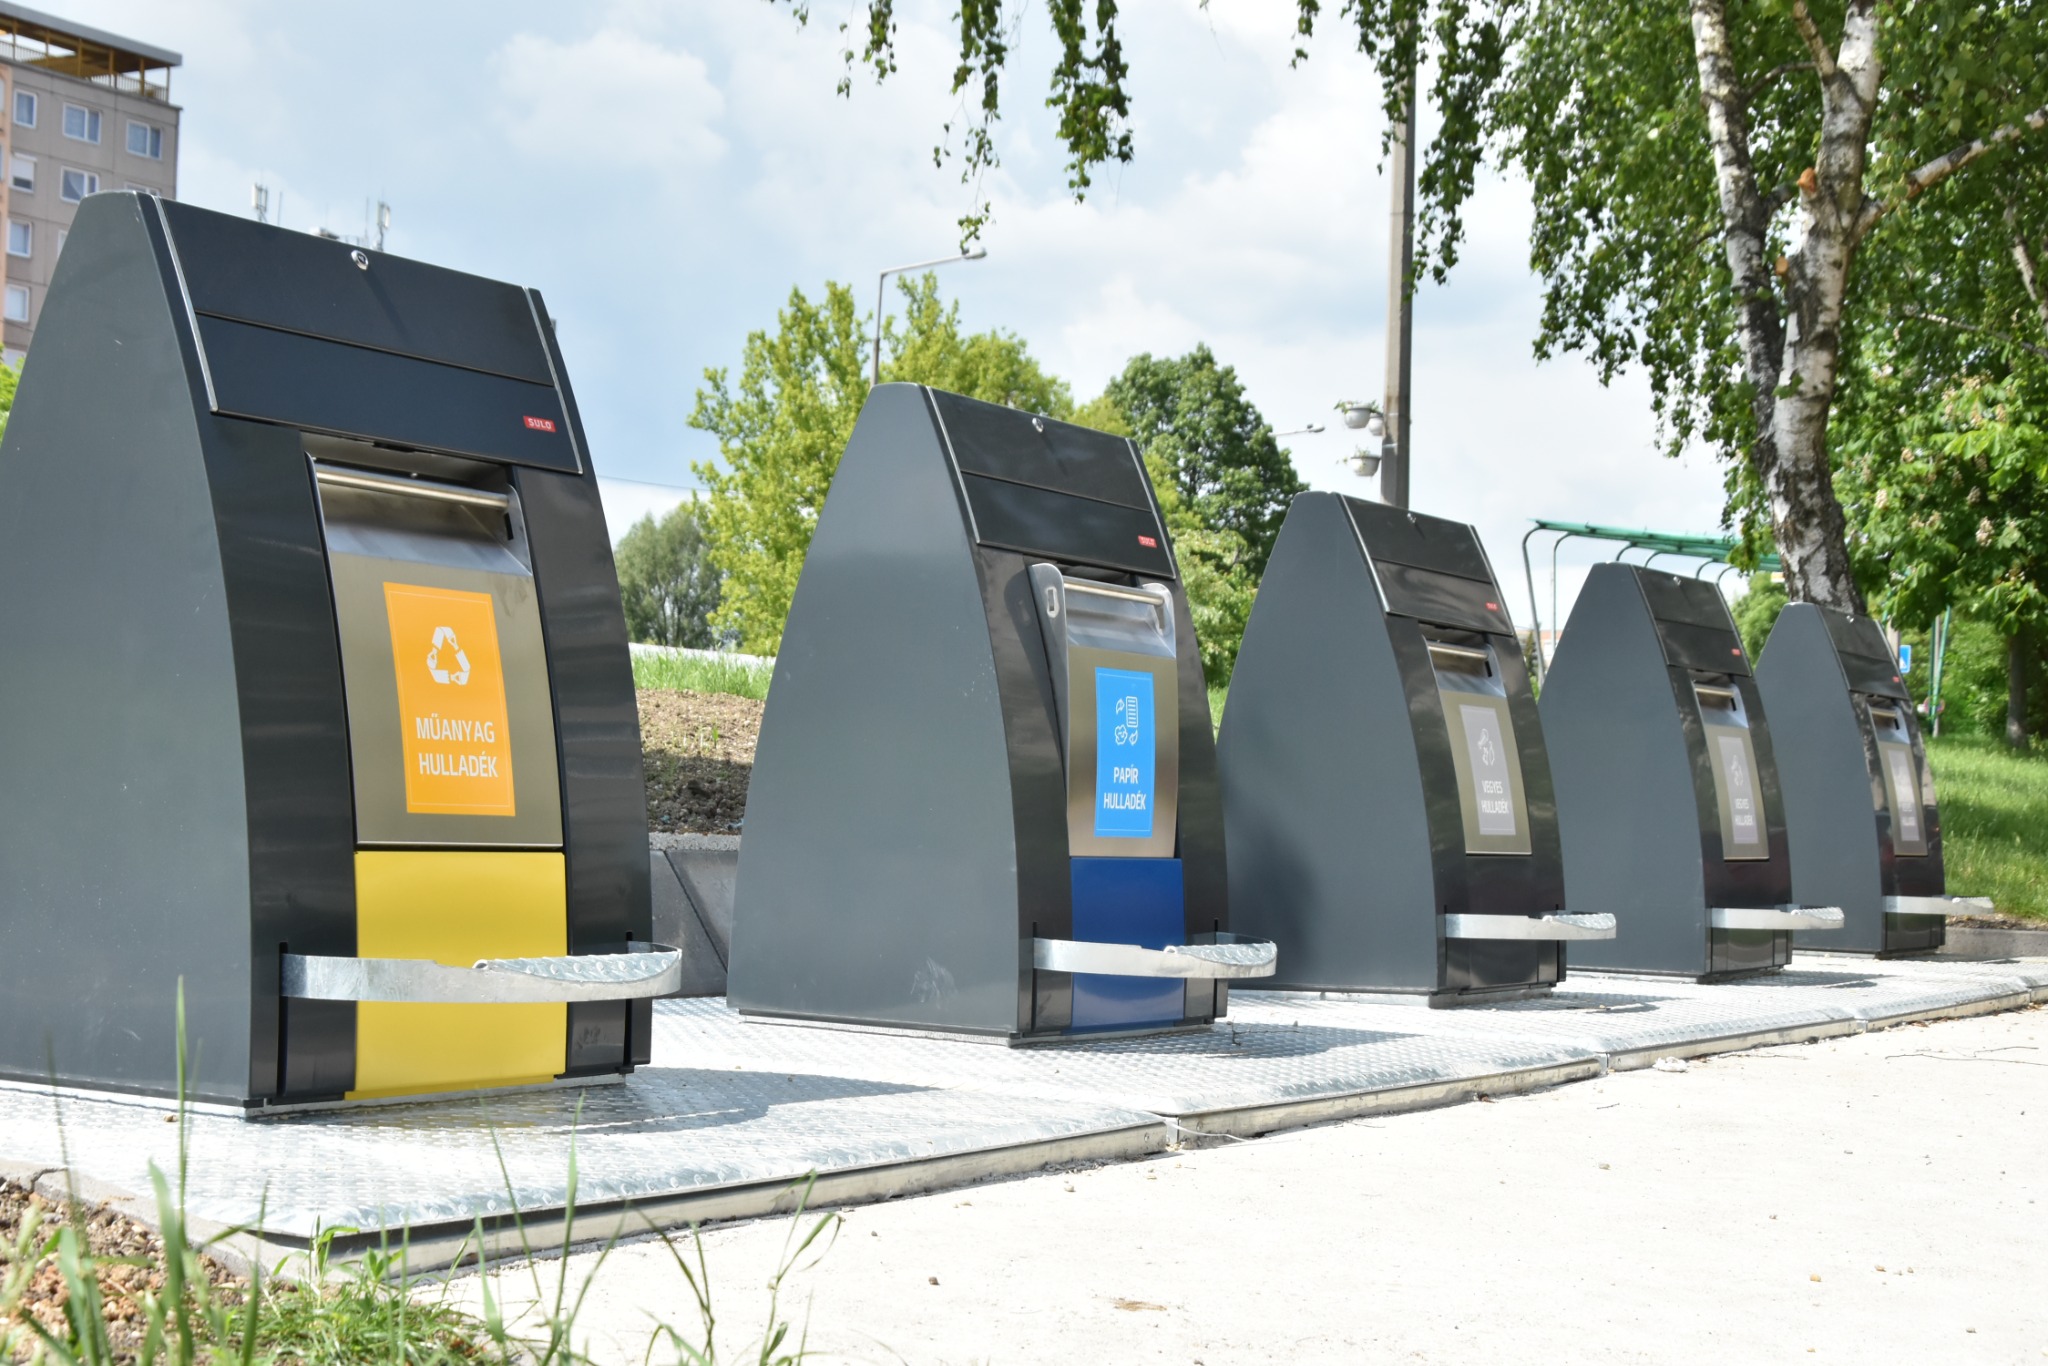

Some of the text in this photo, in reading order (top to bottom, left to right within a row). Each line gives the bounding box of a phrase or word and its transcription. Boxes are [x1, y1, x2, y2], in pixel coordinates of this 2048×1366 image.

[528, 417, 552, 430] SULO
[416, 712, 495, 743] MŰANYAG
[418, 750, 498, 778] HULLADÉK
[1113, 763, 1139, 784] PAPÍR
[1103, 789, 1147, 810] HULLADÉK
